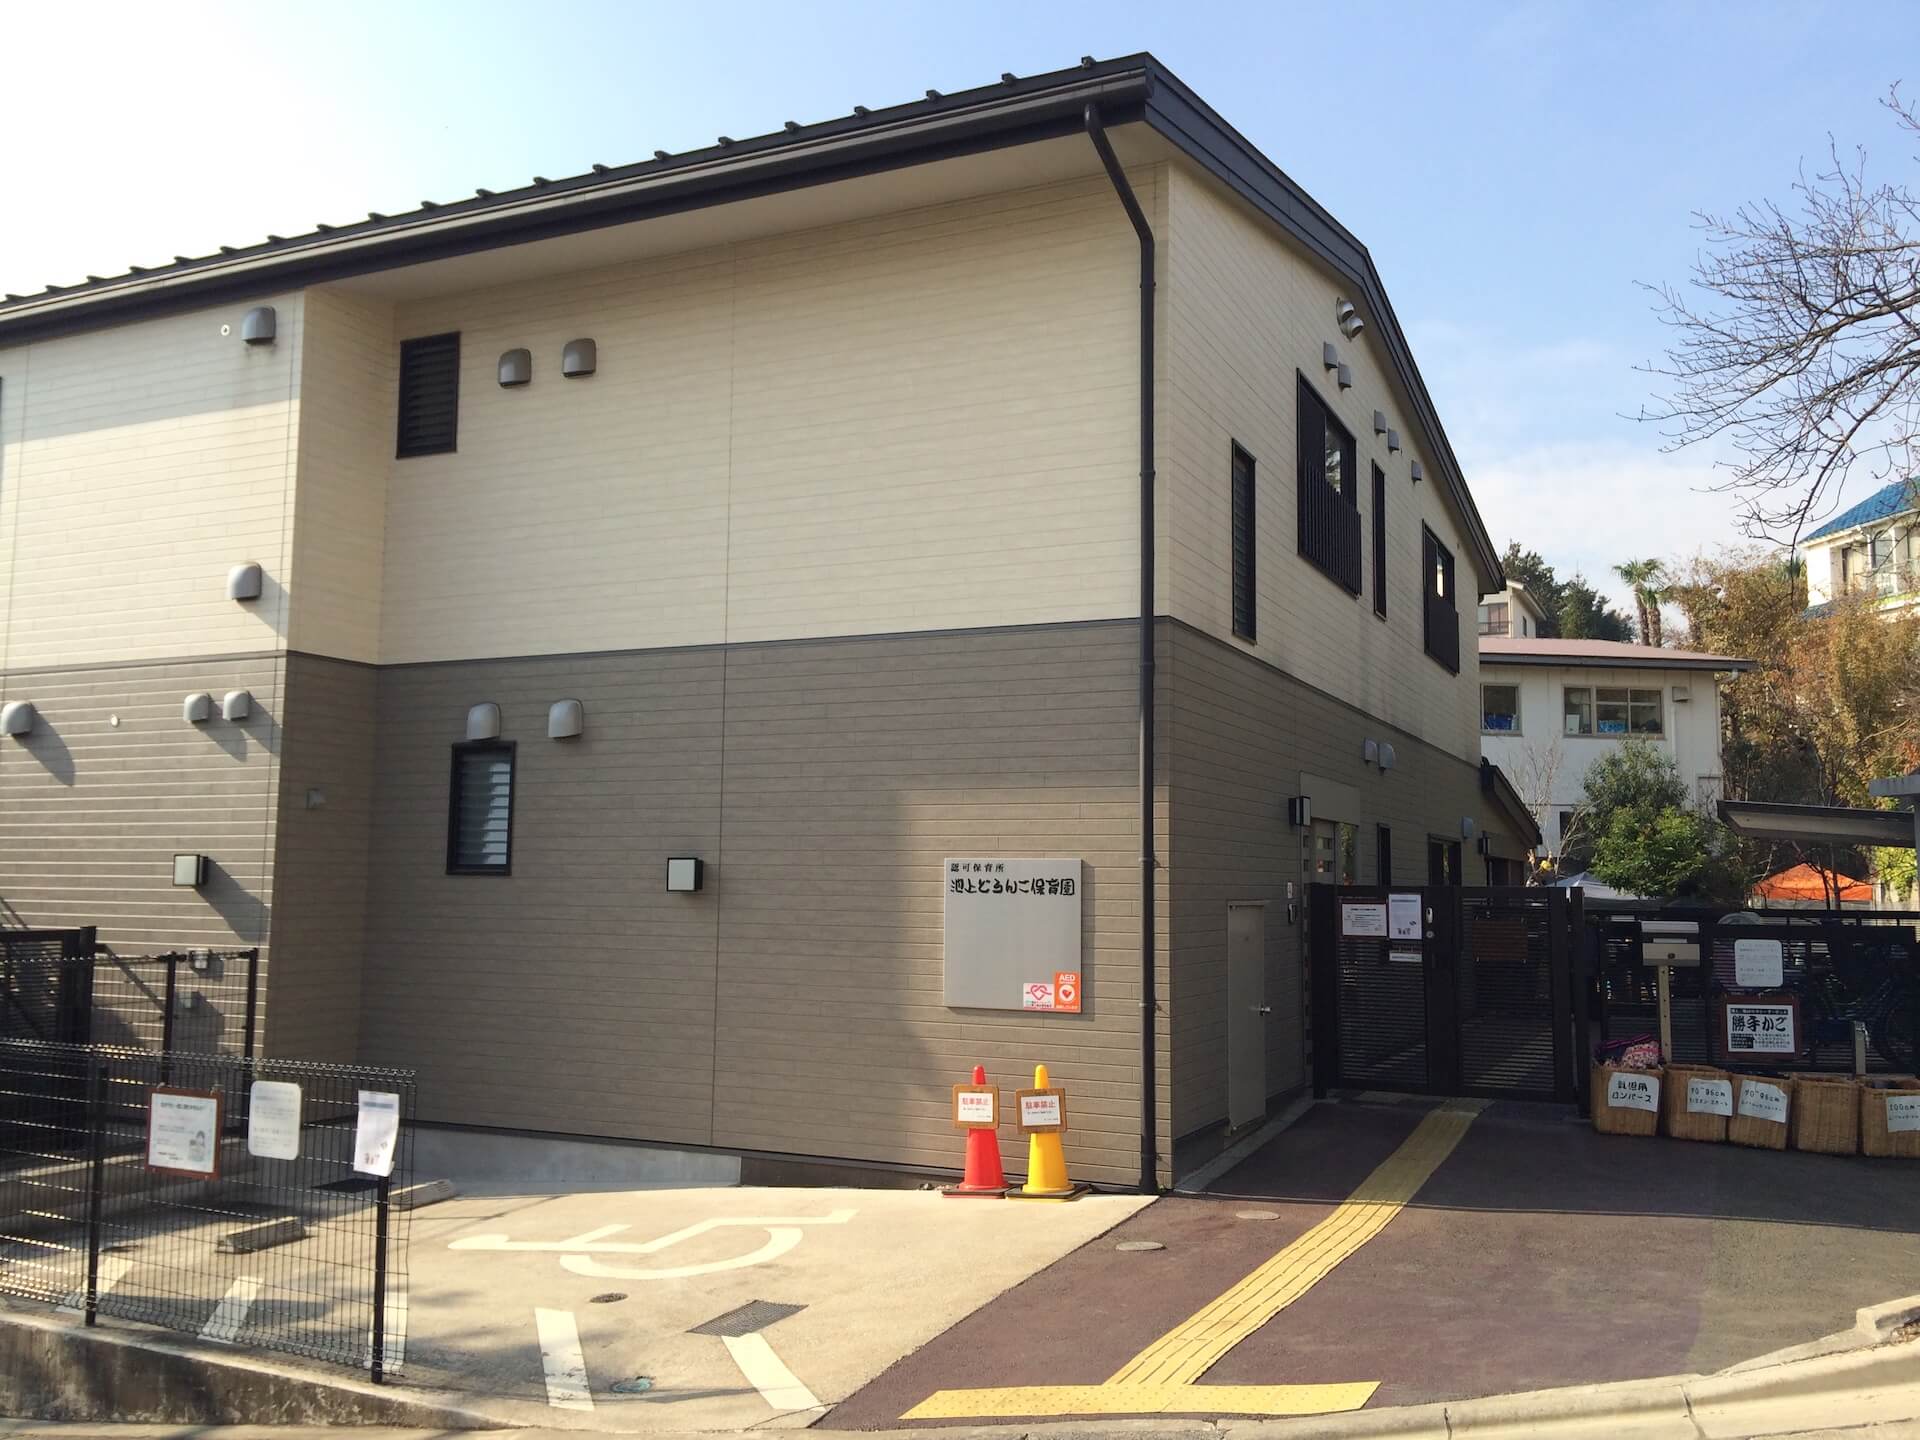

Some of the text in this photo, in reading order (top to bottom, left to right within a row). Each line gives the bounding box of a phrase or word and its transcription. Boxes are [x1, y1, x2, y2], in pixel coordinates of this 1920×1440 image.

[950, 877, 1075, 895] 池上どろんこ保育園
[1731, 1015, 1788, 1032] 勝手かご
[962, 1097, 990, 1105] 駐車禁止
[1025, 1101, 1057, 1109] 駐車禁止
